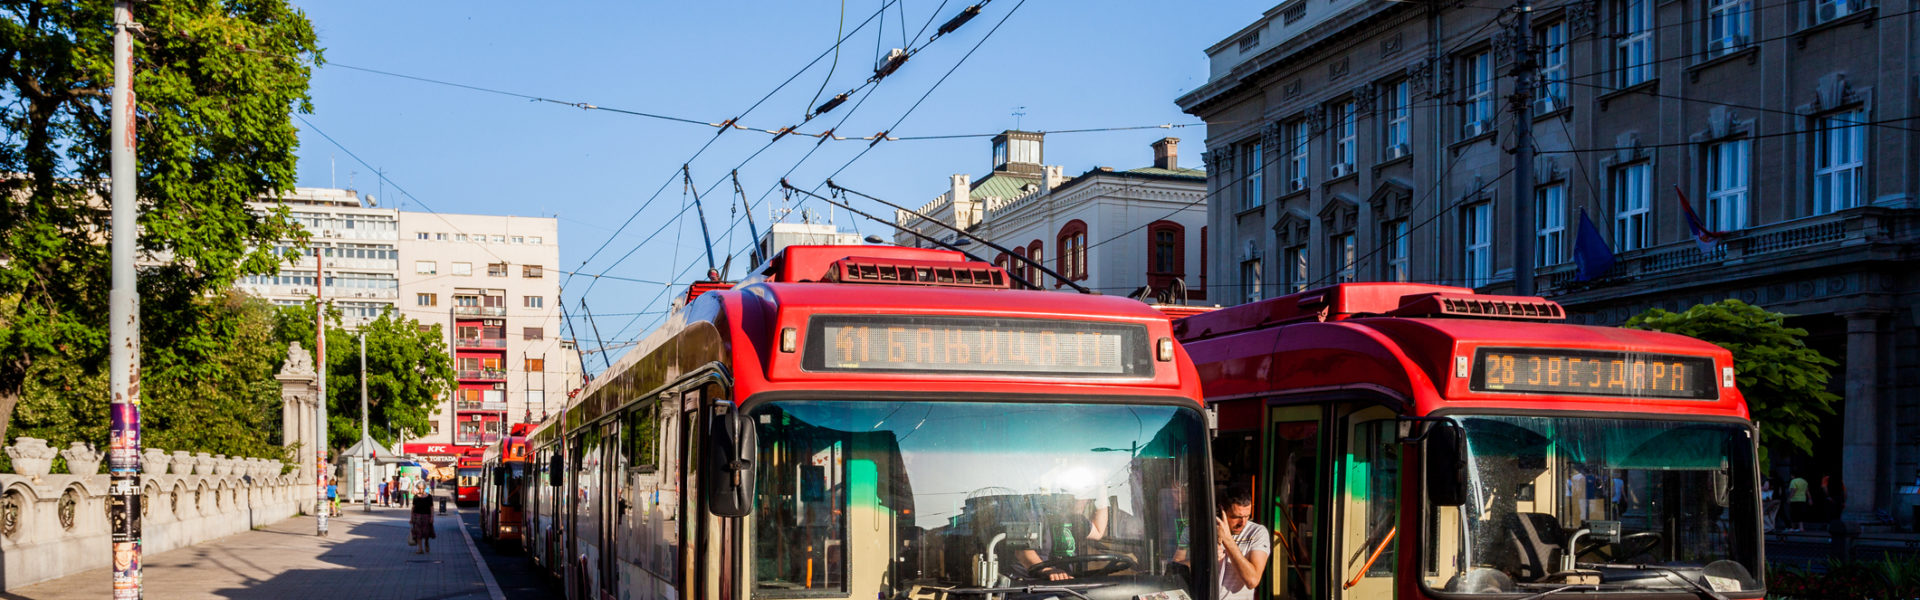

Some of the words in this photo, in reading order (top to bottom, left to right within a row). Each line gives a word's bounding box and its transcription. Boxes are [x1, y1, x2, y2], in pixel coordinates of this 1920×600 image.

[836, 326, 869, 362] 41
[887, 327, 1057, 365] БАЊИЦА
[1487, 354, 1515, 385] 28
[1528, 356, 1684, 391] ЗВЕЗДАРА
